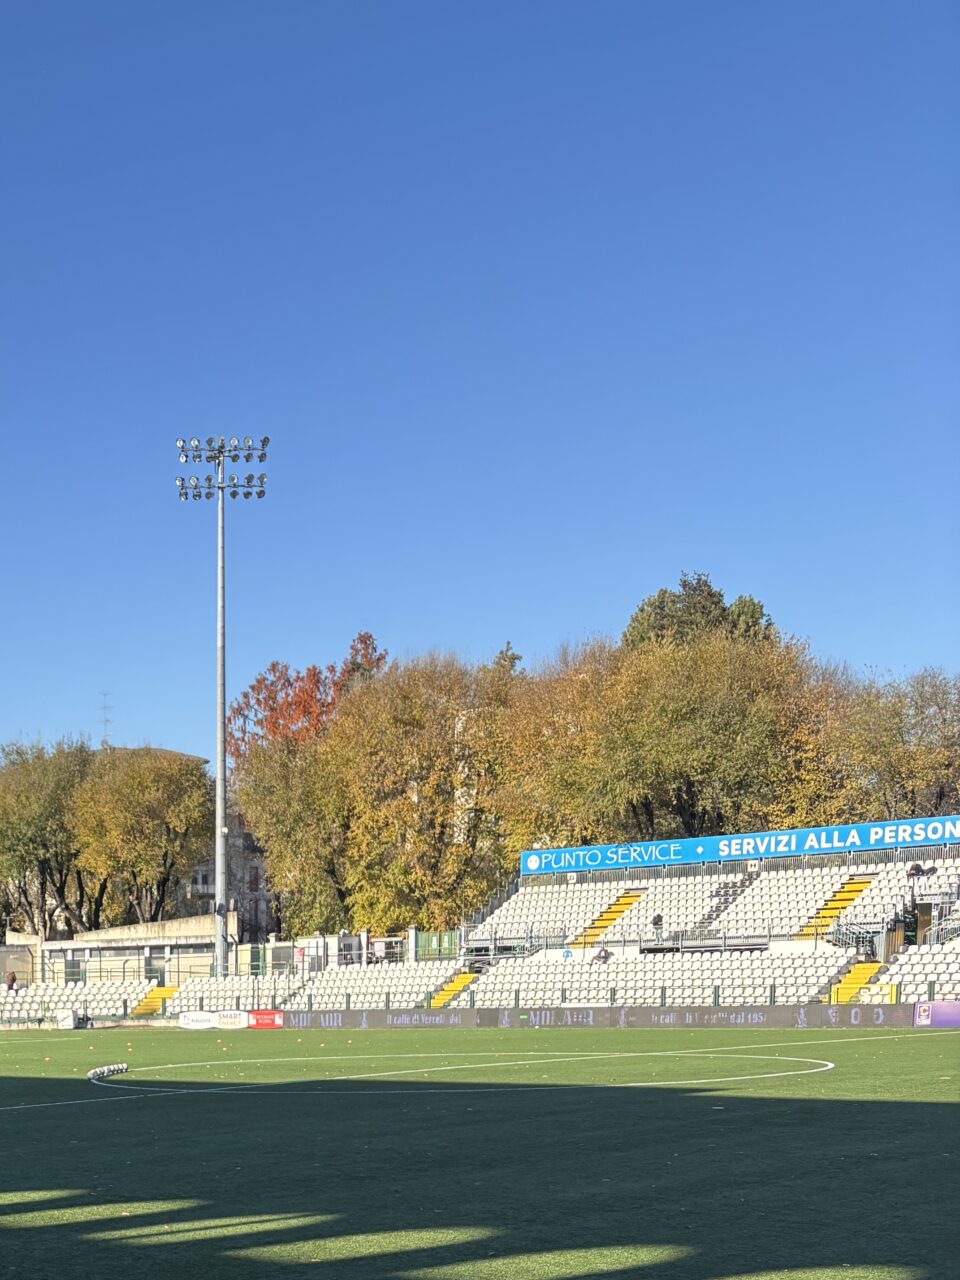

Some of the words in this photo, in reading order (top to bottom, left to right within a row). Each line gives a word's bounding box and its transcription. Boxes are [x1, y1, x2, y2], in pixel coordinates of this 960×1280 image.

[718, 833, 796, 856] SERVIZI
[804, 828, 861, 850] ALLA
[869, 816, 960, 845] PERSON
[541, 849, 602, 869] PUNTO
[605, 843, 682, 865] SERVICE
